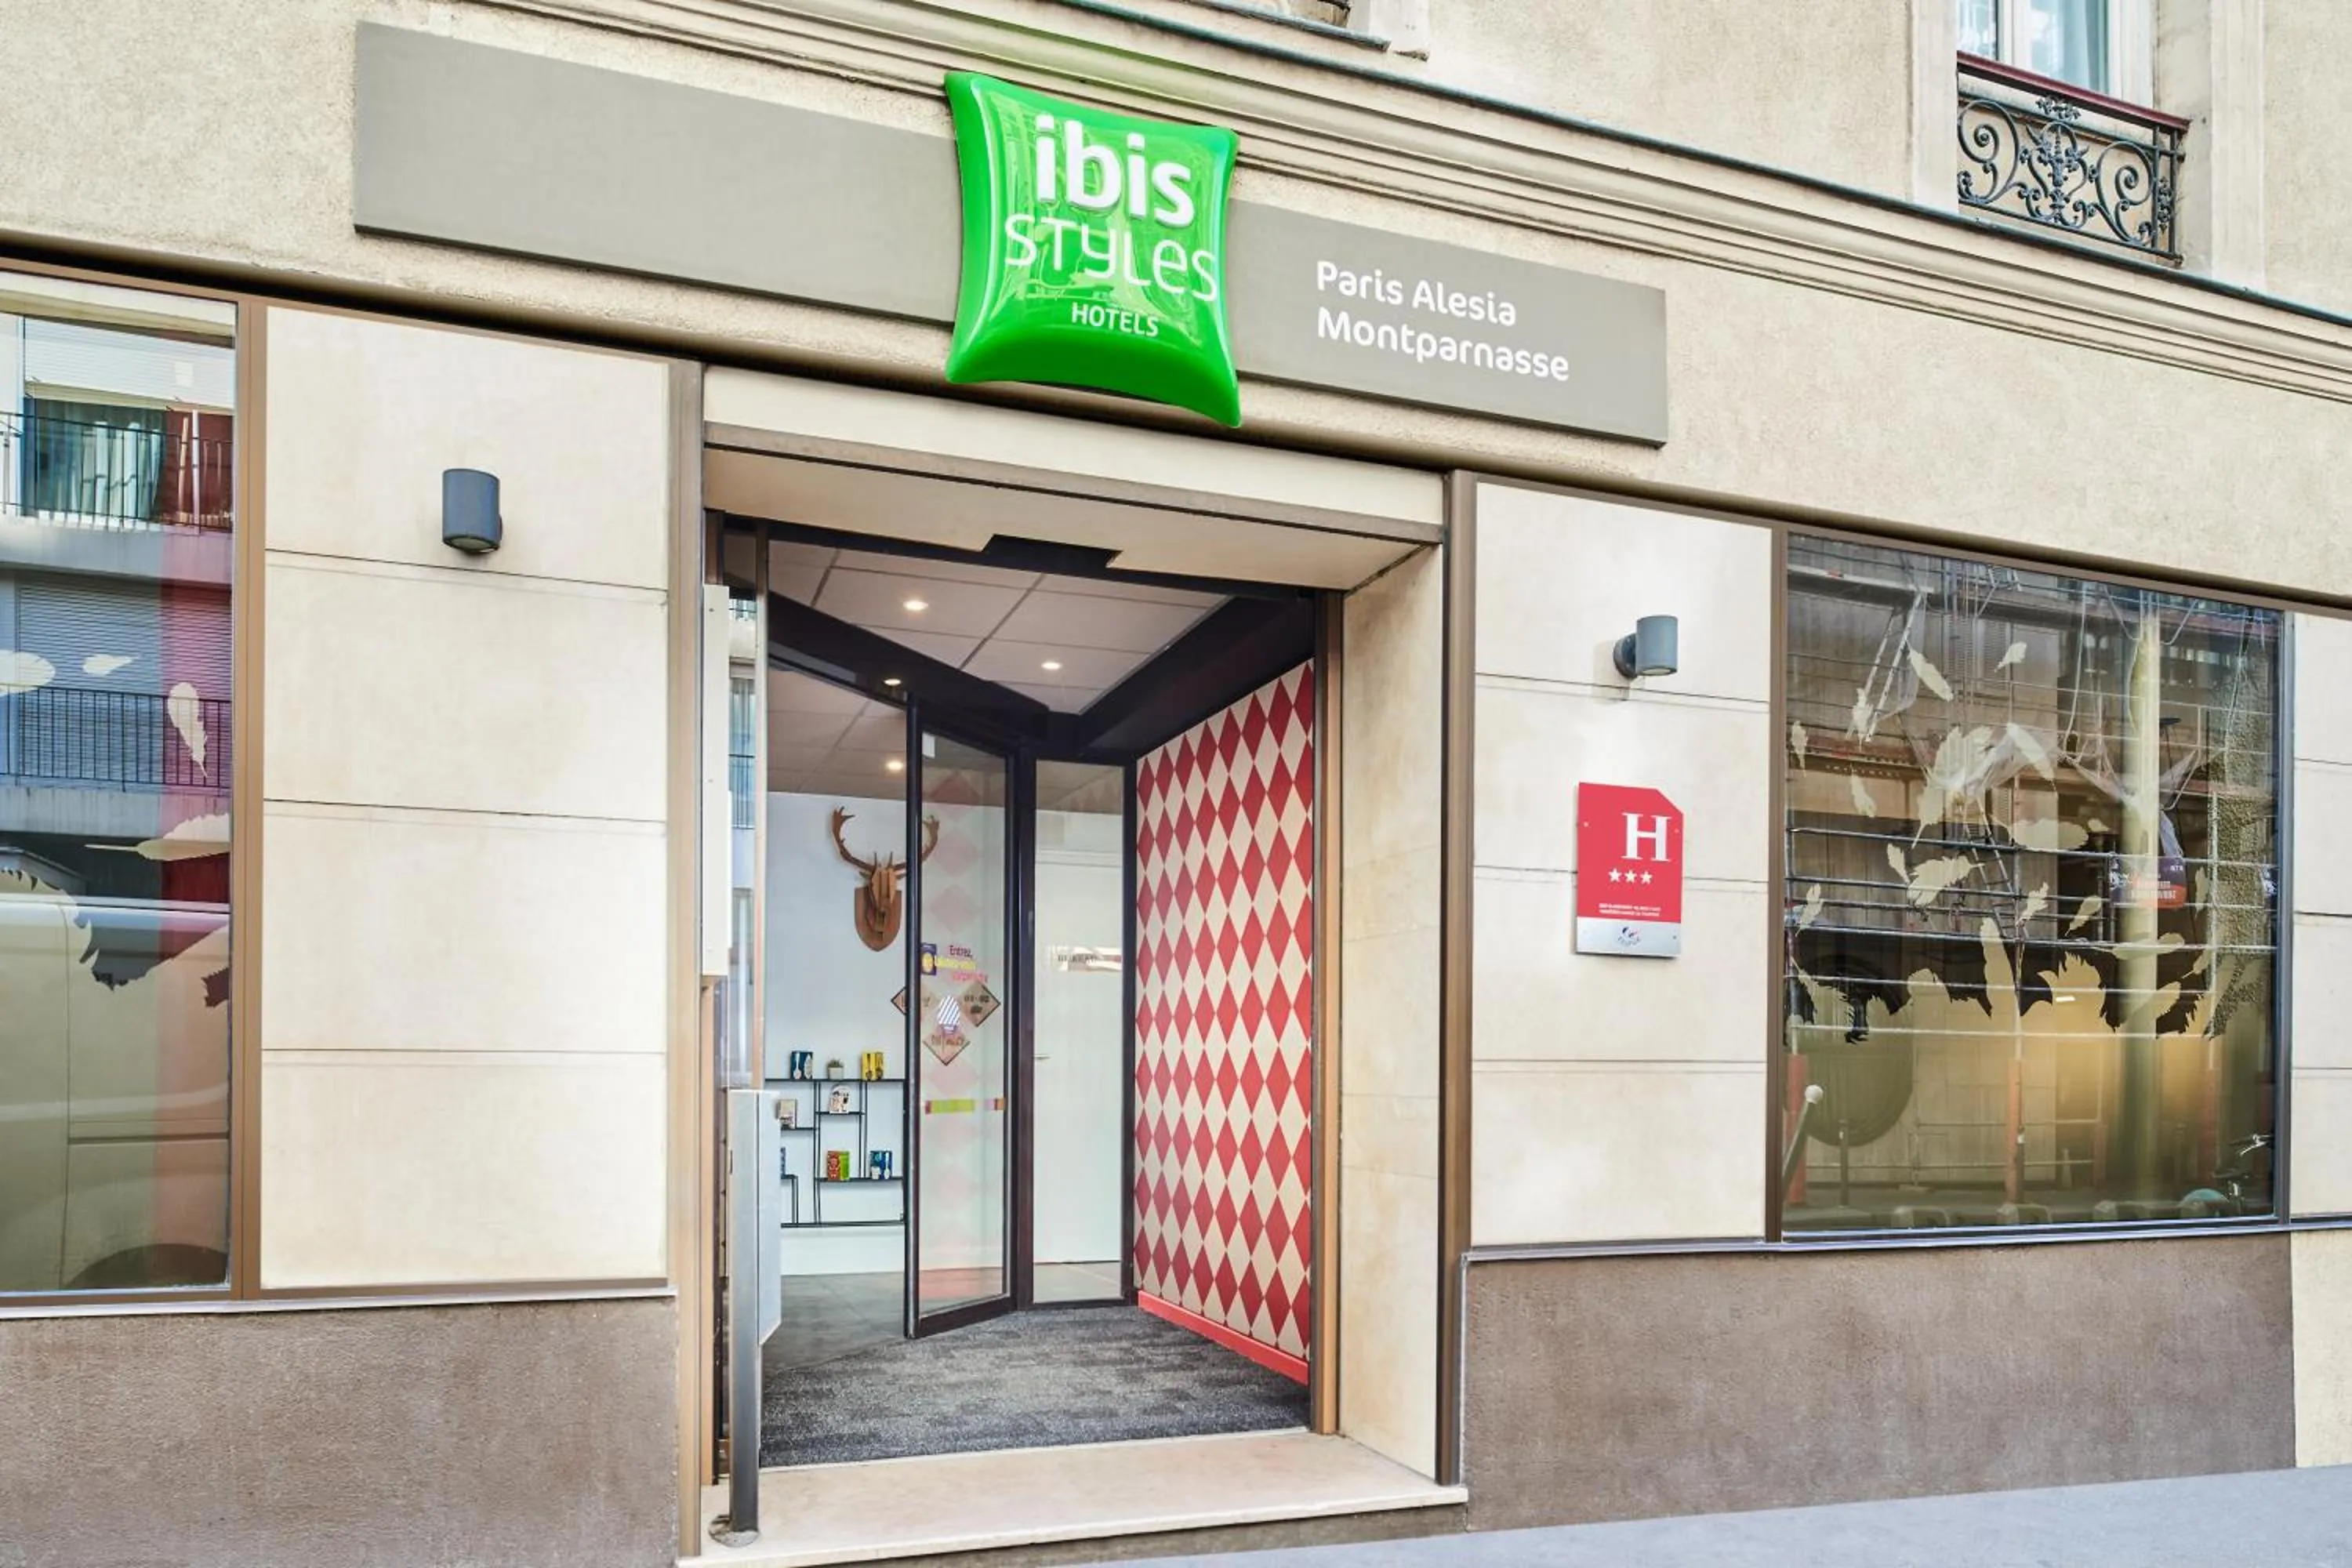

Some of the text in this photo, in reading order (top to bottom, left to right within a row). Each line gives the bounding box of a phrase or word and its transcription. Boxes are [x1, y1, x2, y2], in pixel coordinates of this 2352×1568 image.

[1035, 114, 1194, 227] ibis
[1072, 302, 1160, 337] HOTELS
[1316, 260, 1516, 326] Paris Alesia
[1318, 307, 1569, 381] Montparnasse
[1621, 812, 1671, 862] H
